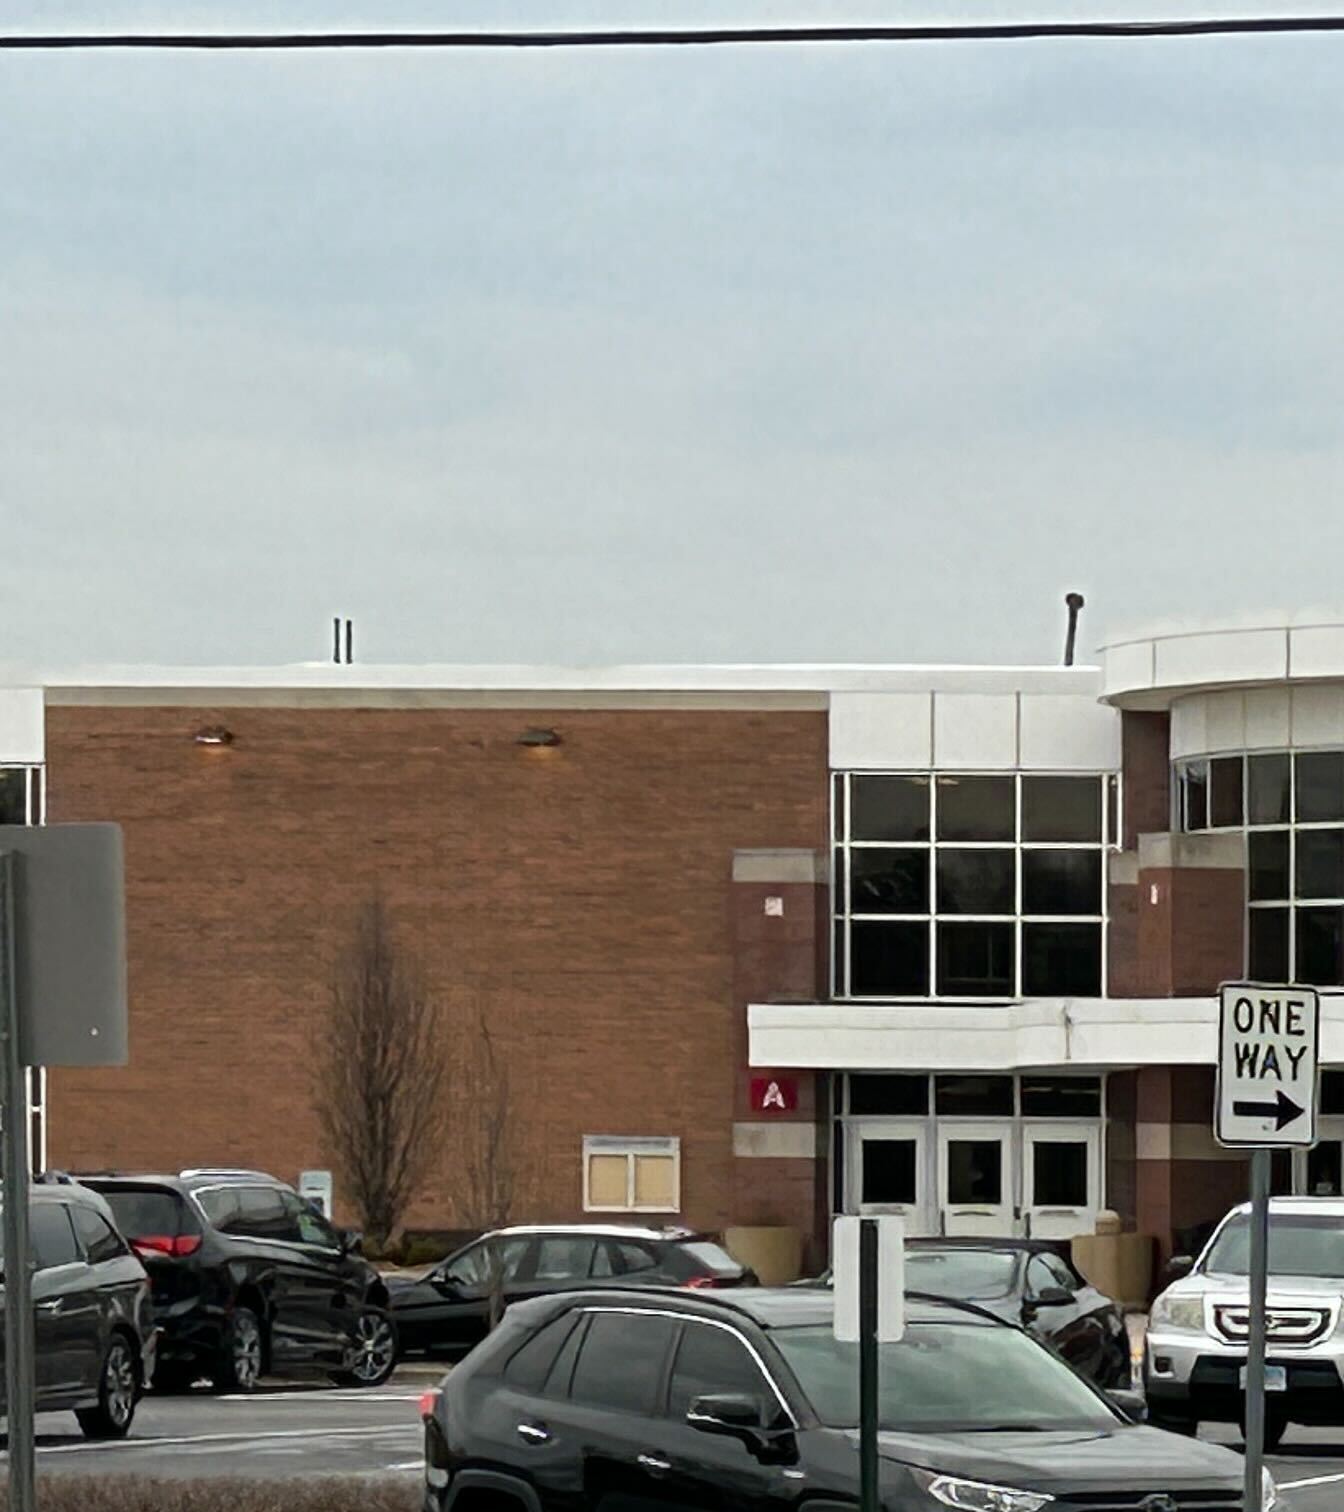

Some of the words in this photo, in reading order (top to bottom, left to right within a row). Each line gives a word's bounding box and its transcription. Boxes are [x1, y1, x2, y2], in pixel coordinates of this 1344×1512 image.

[1233, 997, 1306, 1036] ONE
[1234, 1042, 1308, 1082] WAY
[762, 1081, 786, 1108] A
